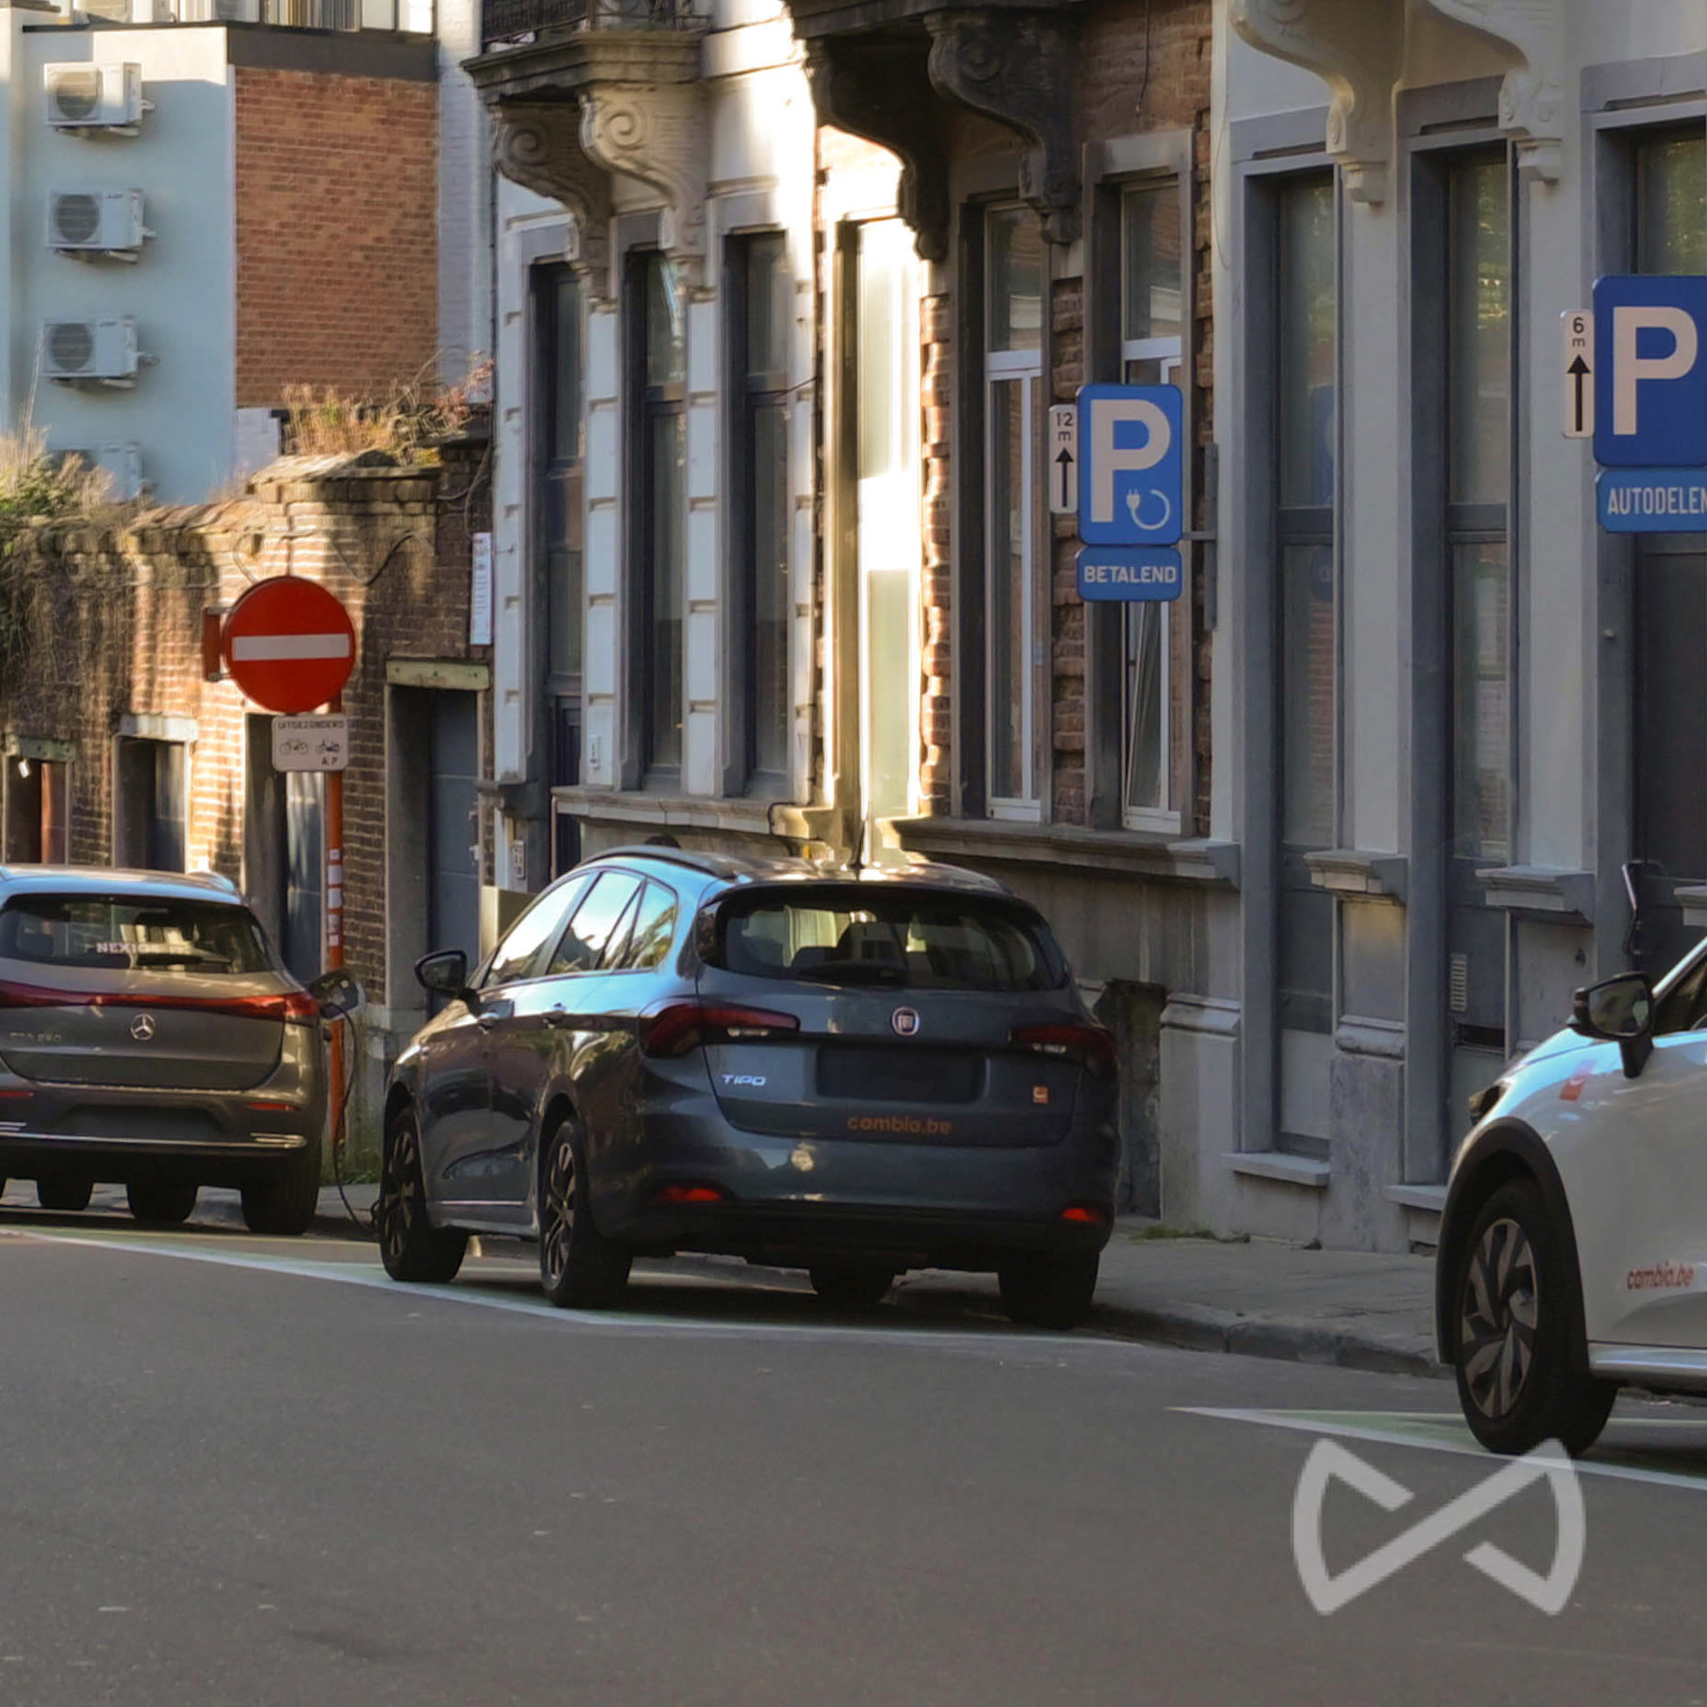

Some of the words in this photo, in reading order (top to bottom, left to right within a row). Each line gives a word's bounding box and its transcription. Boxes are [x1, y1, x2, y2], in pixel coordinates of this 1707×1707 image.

[1572, 316, 1585, 334] 6
[1572, 337, 1586, 348] m
[1613, 306, 1698, 435] P
[1056, 412, 1074, 427] 12
[1057, 431, 1072, 442] m
[1090, 399, 1171, 523] P
[1083, 566, 1177, 583] BETALEND
[721, 1074, 766, 1086] TIPO
[847, 1116, 953, 1134] cambio.be
[1627, 1260, 1695, 1290] cambio.be
